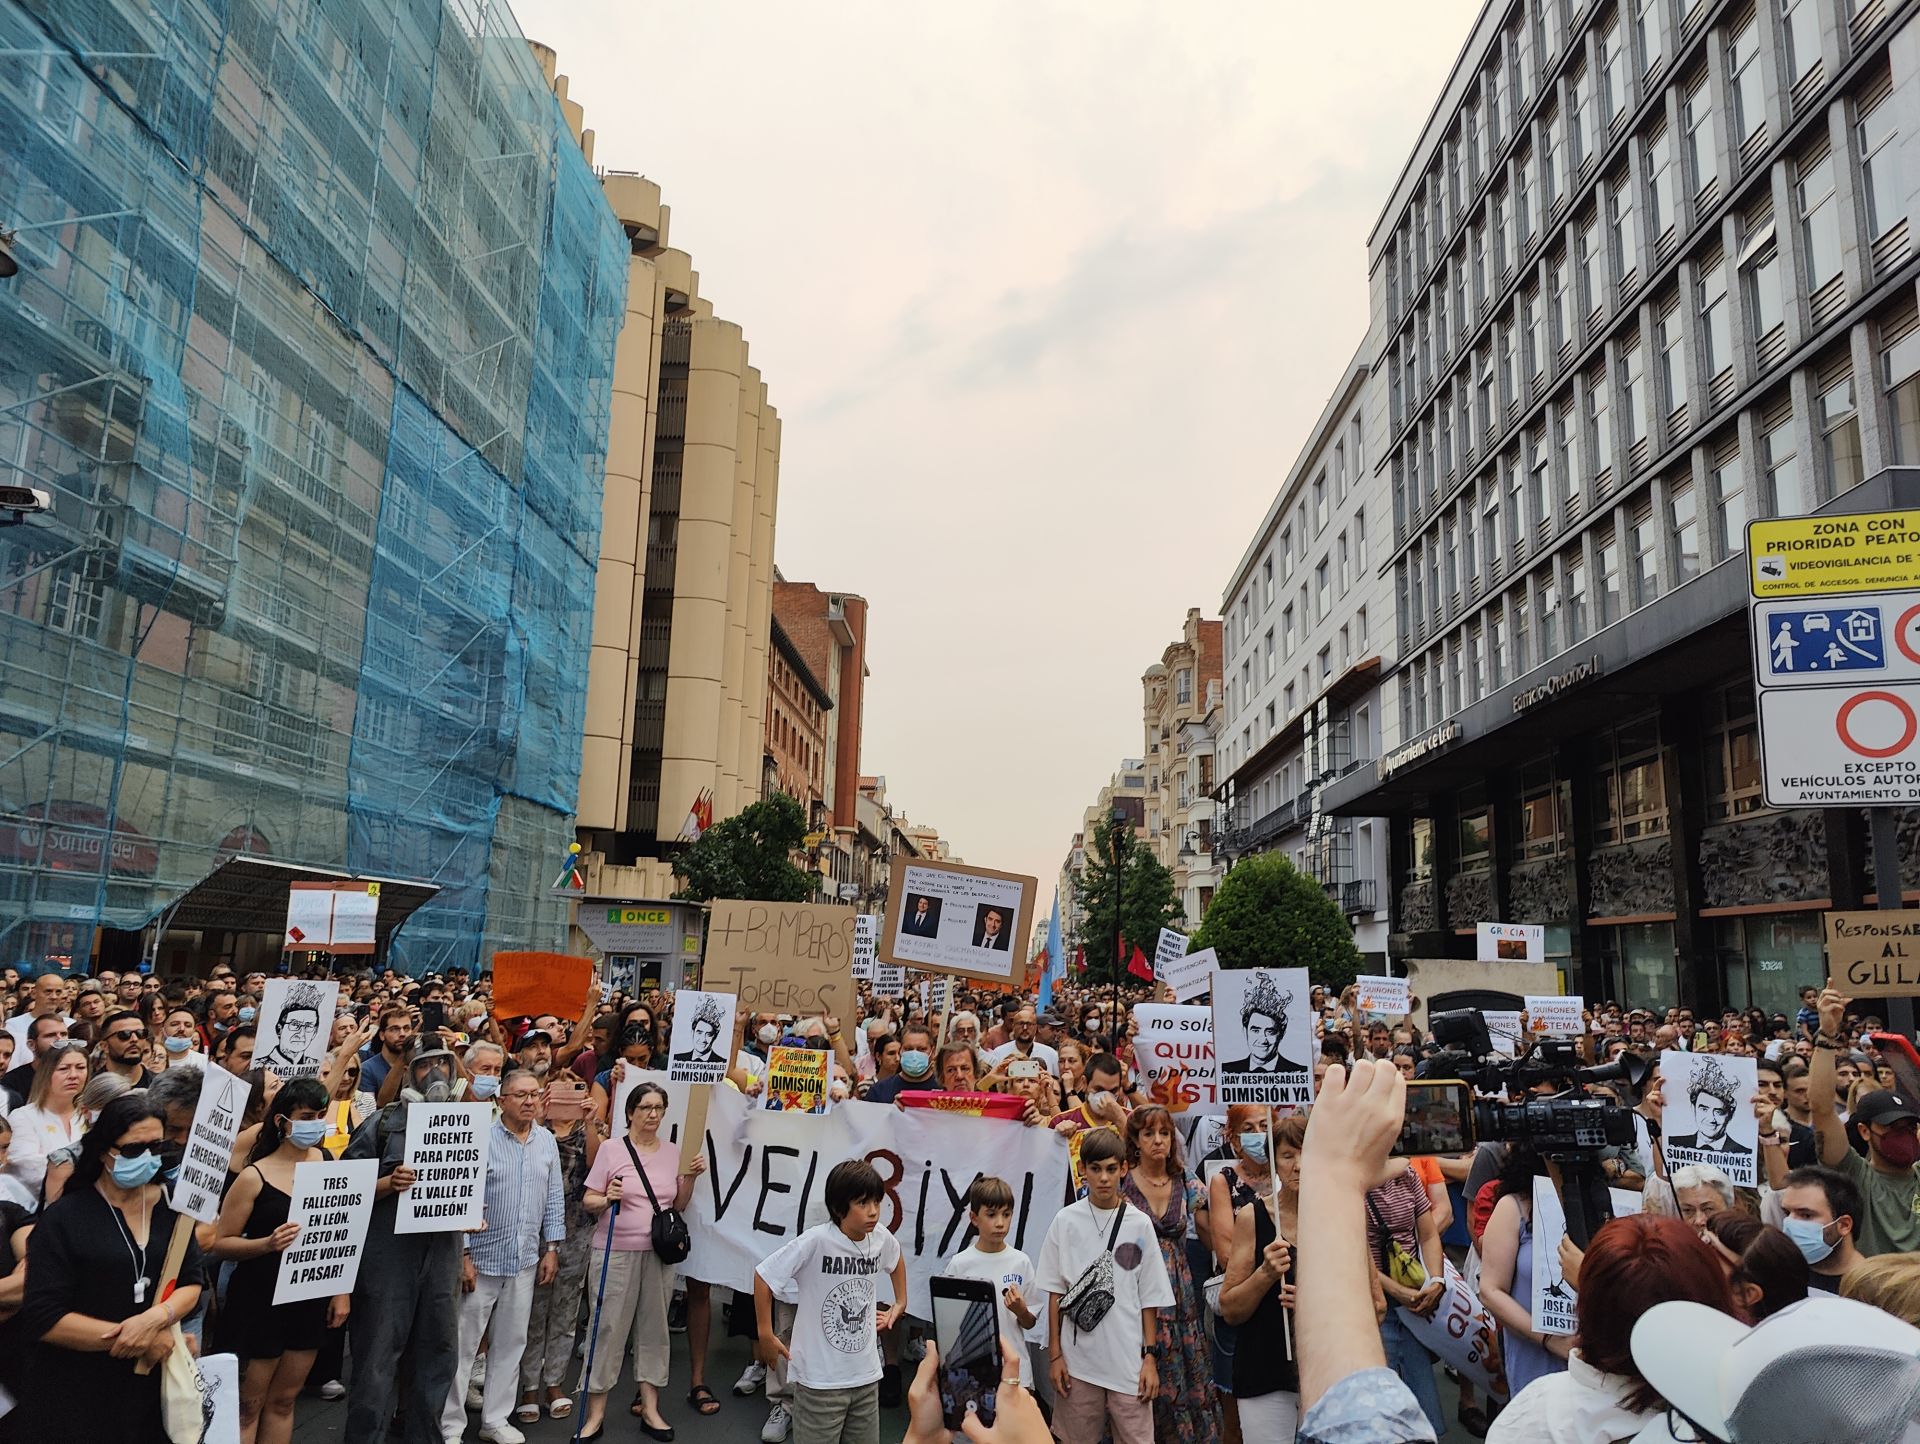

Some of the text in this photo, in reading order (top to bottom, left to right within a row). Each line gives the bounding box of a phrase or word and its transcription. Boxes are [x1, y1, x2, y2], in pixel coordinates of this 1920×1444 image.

[1814, 518, 1905, 535] ZONA CON
[1766, 536, 1855, 553] PRIORIDAD
[1790, 554, 1913, 571] VIDEOVIGILANCIA DE
[1762, 583, 1801, 591] CONTROL
[1865, 575, 1908, 584] DENUNCIA
[1844, 762, 1916, 773] EXCEPTO
[1781, 775, 1866, 787] VEHÍCULOS
[1799, 789, 1901, 800] AYUNTAMIENTO
[47, 828, 136, 859] Santader
[626, 911, 665, 922] ONCE
[1881, 942, 1909, 958] AL
[1151, 1019, 1173, 1030] no
[785, 1052, 816, 1062] GOBIERNO
[671, 1071, 714, 1083] DIMISIÓN
[778, 1063, 820, 1075] AUTONÓMICO
[1148, 1066, 1163, 1079] el
[771, 1075, 823, 1094] DIMISIÓN
[1221, 1074, 1309, 1085] ¡HAY RESPONSABLES!
[1222, 1085, 1310, 1103] DIMISIÓN YA
[207, 1109, 234, 1133] ¡POR LA
[429, 1114, 470, 1128] ¡APOYO
[194, 1123, 230, 1150] DECLARACIÓN
[423, 1132, 473, 1145] URGENTE
[414, 1149, 479, 1163] PARA PICOS
[1667, 1148, 1752, 1168] SUAREZ-QUIÑONES
[182, 1166, 204, 1188] NIVEL
[427, 1167, 469, 1181] EUROPA
[473, 1167, 479, 1179] Y
[1733, 1168, 1752, 1183] YA!
[323, 1177, 348, 1190] TRES
[411, 1185, 473, 1200] EL VALLE DE
[186, 1192, 206, 1213] LEÓN!
[302, 1193, 362, 1210] FALLECIDOS
[414, 1201, 468, 1218] VALDEÓN!
[308, 1210, 350, 1227] EN LEÓN.
[301, 1229, 348, 1246] ¡ESTO NO
[286, 1245, 357, 1265] PUEDE VOLVER
[290, 1264, 344, 1285] A PASAR!
[1543, 1299, 1565, 1314] JOSÉ
